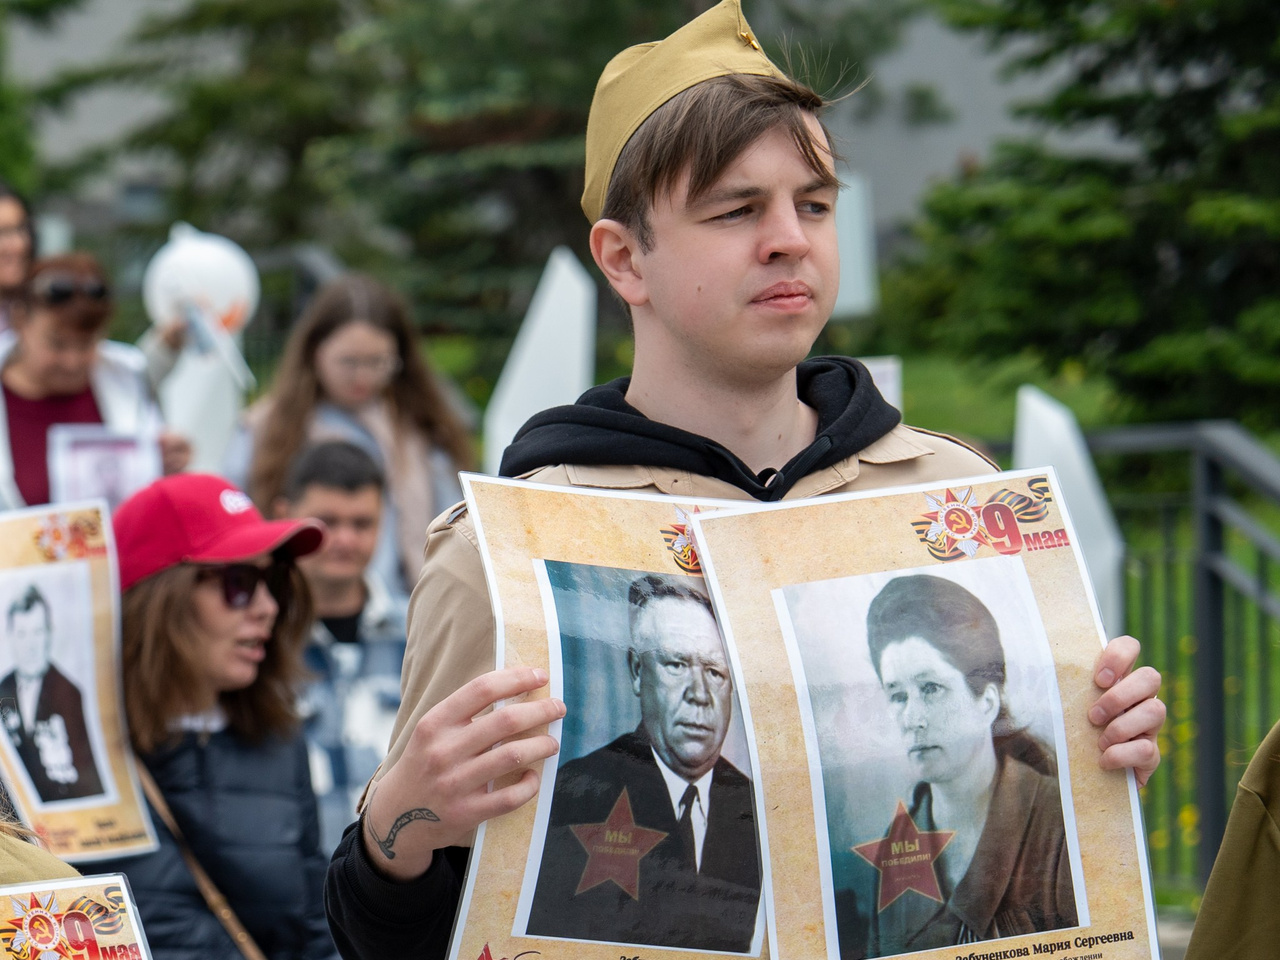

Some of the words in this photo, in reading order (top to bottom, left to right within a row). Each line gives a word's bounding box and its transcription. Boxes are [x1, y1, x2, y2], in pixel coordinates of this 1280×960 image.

[982, 503, 1023, 555] 9
[1023, 529, 1070, 551] мая
[605, 830, 633, 843] МЫ
[890, 839, 920, 855] МЫ
[881, 853, 931, 867] ПОБЕДИЛИ!
[1032, 939, 1071, 955] Мария
[1074, 930, 1134, 949] Сергеевна
